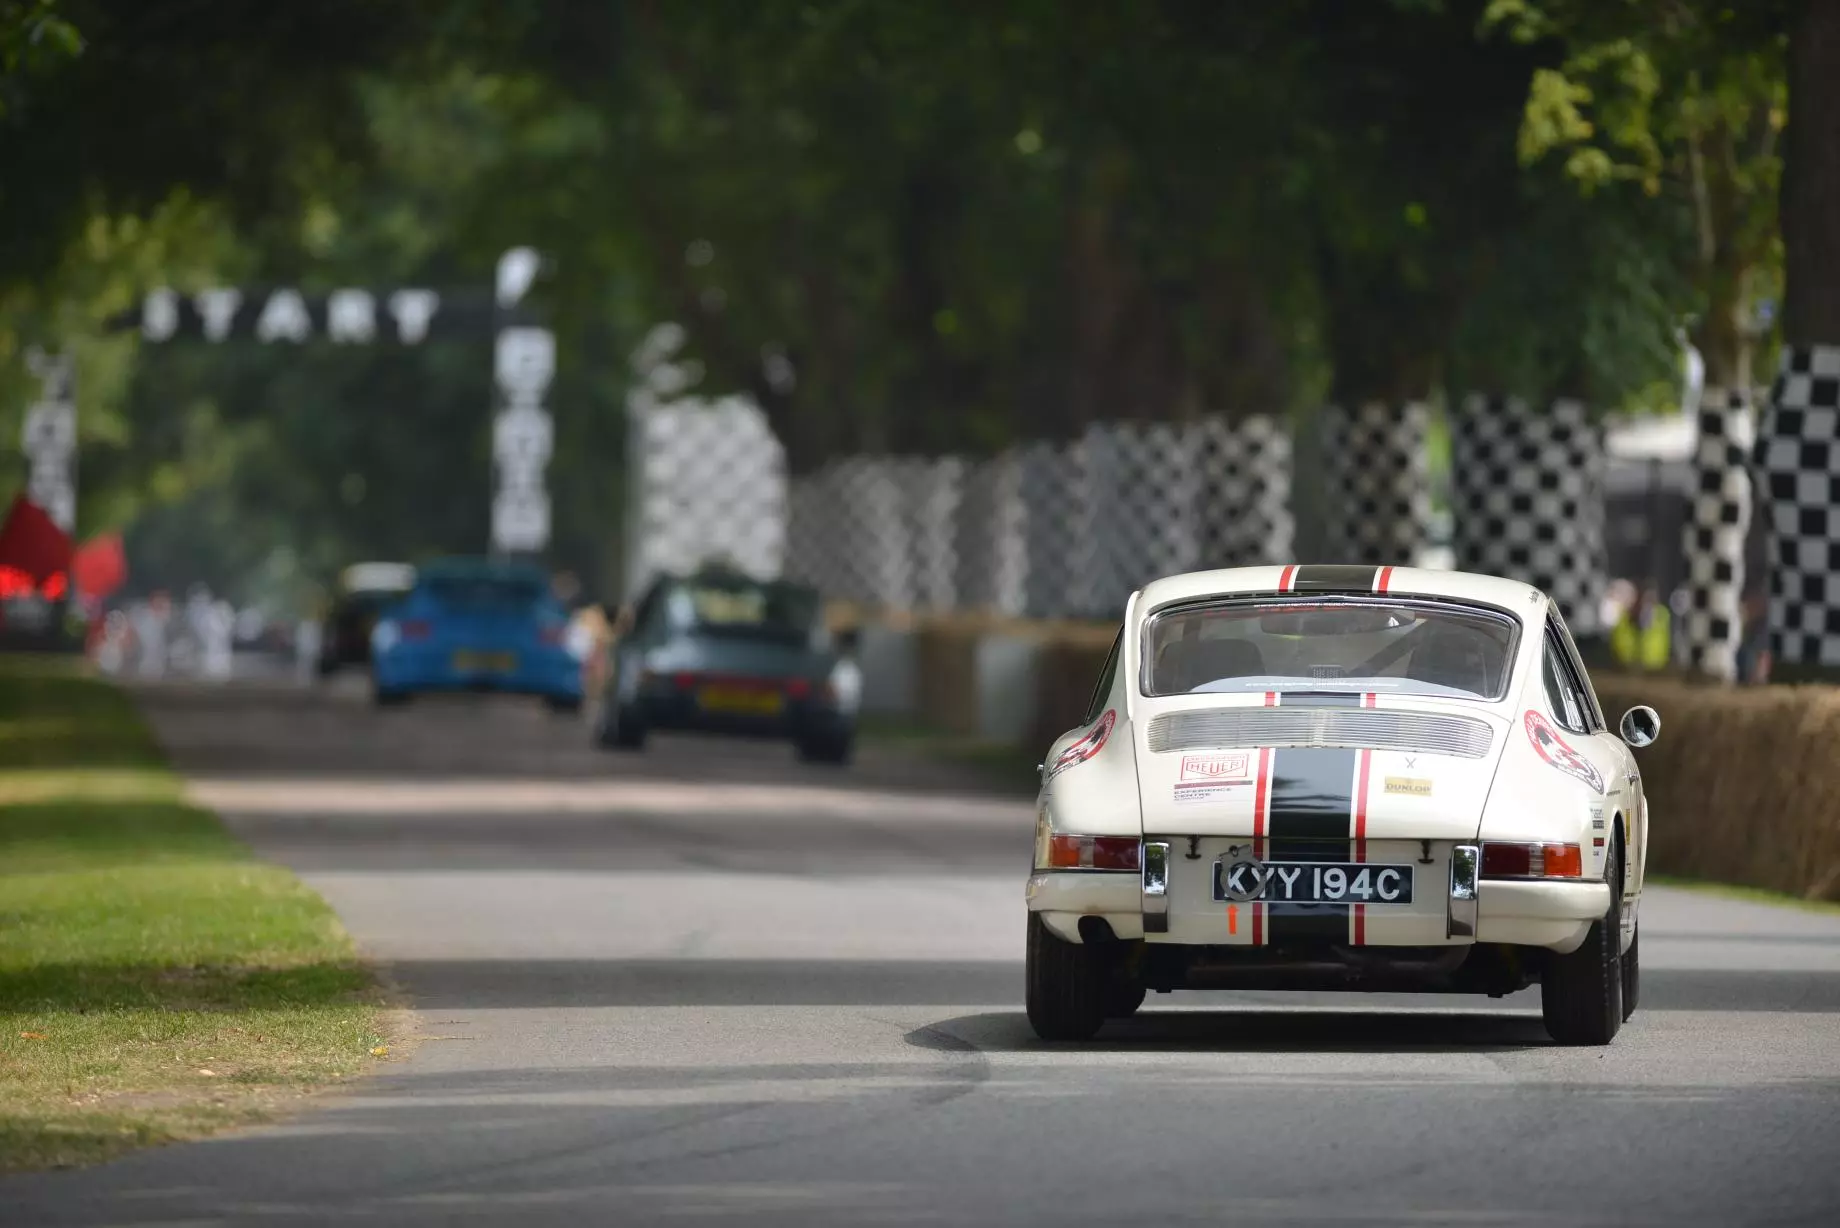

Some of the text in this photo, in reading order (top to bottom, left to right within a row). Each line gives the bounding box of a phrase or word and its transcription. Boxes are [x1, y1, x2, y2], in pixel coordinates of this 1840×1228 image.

[1190, 761, 1239, 774] HEUER
[1386, 783, 1431, 793] DUNLOP
[1225, 867, 1400, 900] KYY 194C
